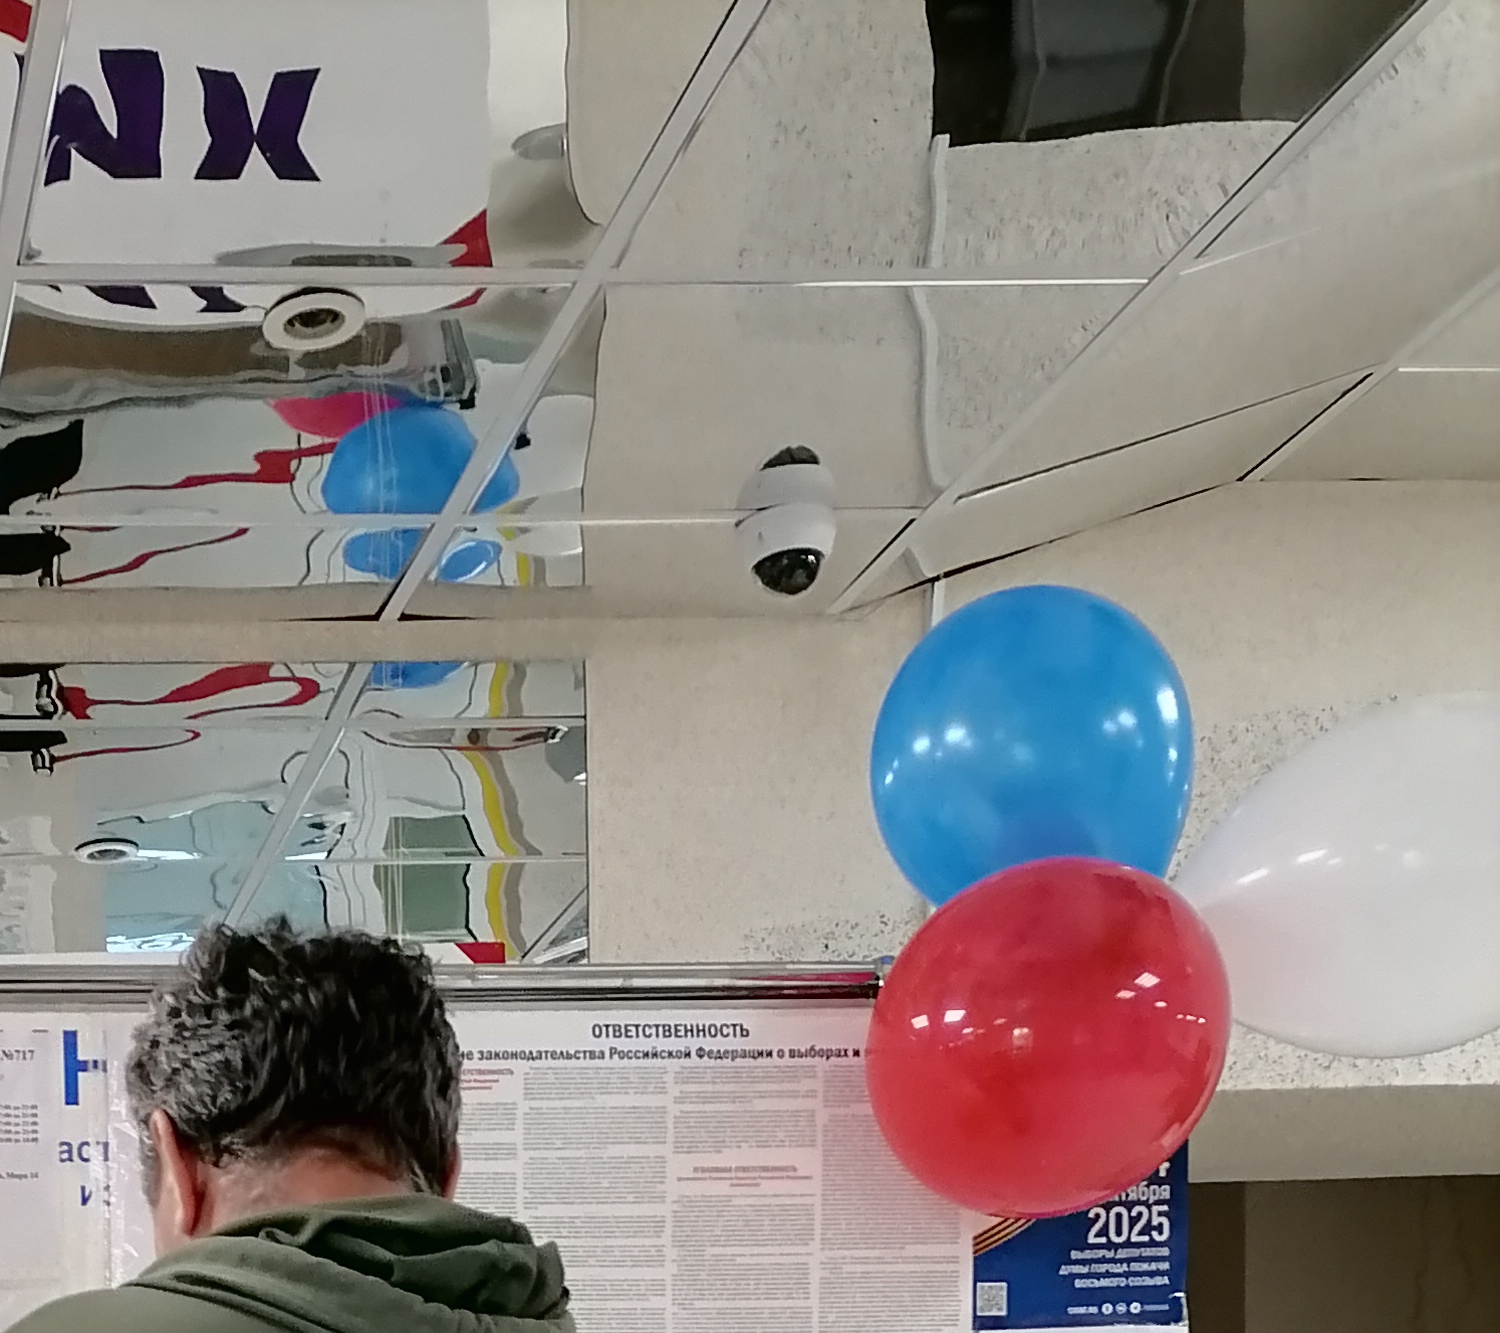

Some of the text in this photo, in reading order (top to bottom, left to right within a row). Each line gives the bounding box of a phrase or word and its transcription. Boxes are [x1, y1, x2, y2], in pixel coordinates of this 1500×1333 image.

[591, 1022, 750, 1039] ОТВЕТСТВЕННОСТЬ
[477, 1046, 605, 1063] законодательства
[609, 1044, 691, 1061] Российской
[695, 1044, 774, 1062] Федерации
[788, 1045, 850, 1061] выборах
[1087, 1204, 1170, 1243] 2025
